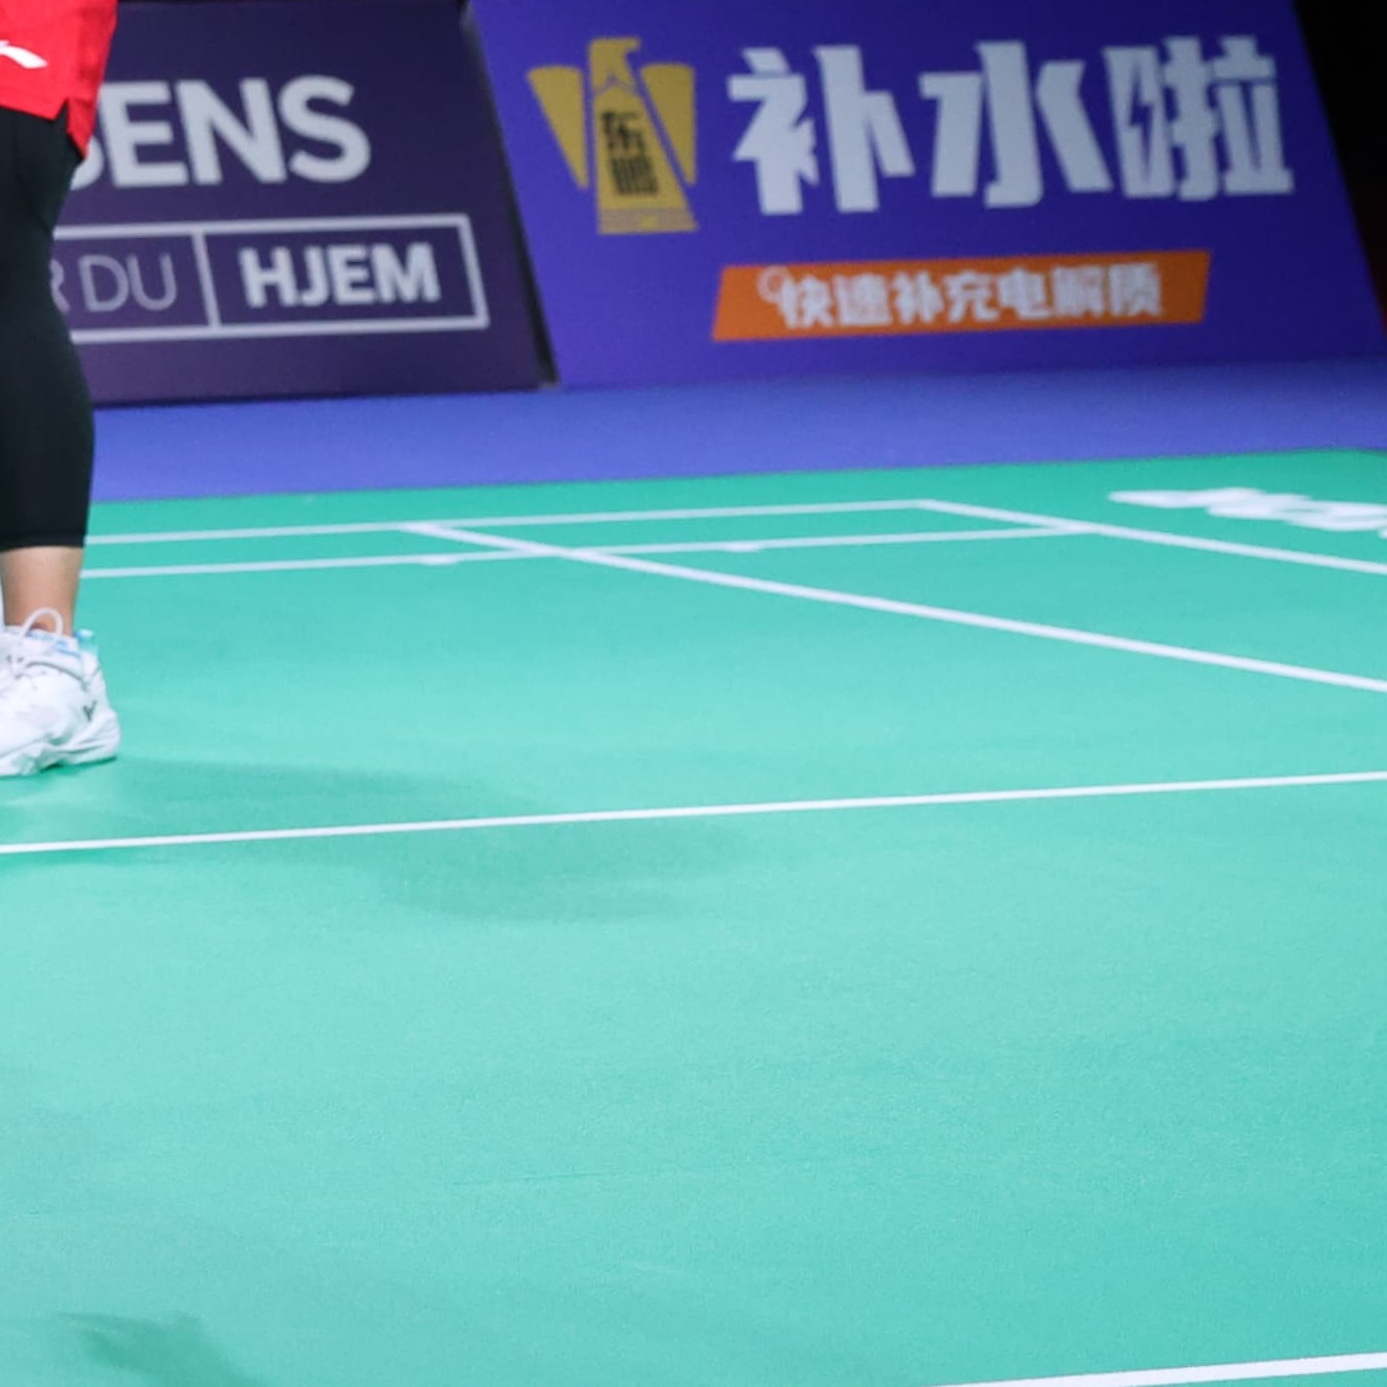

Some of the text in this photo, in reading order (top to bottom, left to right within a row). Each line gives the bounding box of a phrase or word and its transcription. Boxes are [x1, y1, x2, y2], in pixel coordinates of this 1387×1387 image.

[728, 35, 1294, 215] 补水啦
[78, 253, 177, 312] DU
[238, 242, 441, 307] HJEM
